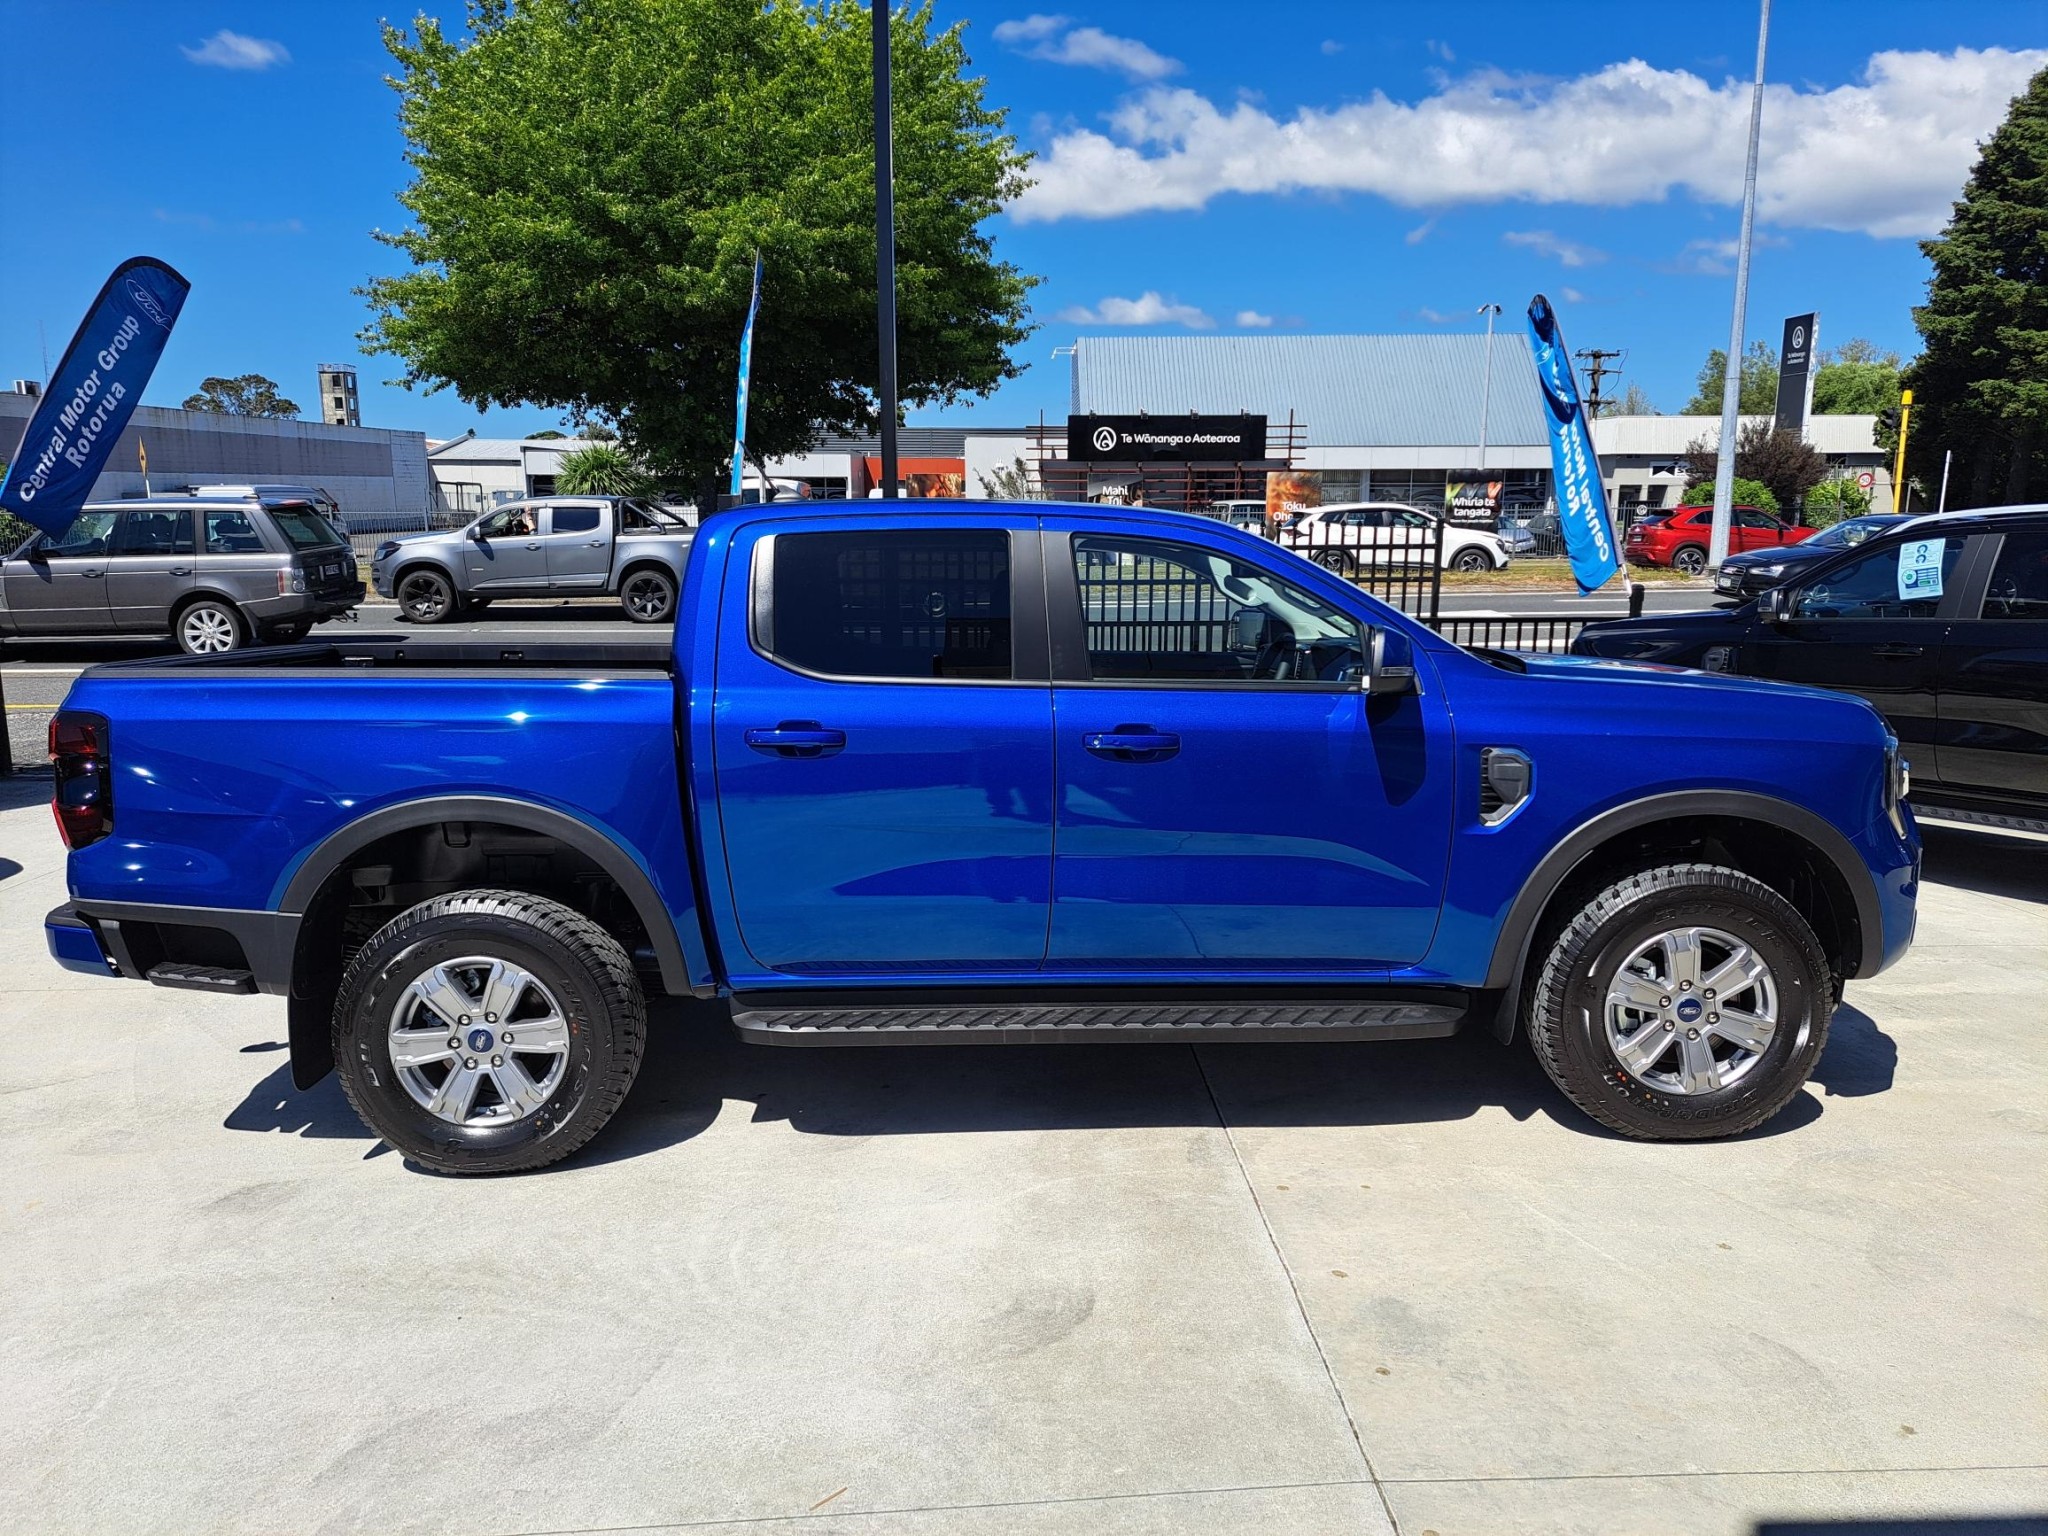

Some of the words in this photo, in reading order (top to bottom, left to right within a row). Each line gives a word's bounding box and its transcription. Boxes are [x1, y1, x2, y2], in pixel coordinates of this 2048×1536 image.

[131, 289, 170, 327] Ford
[20, 427, 67, 502] Central
[60, 369, 101, 431] Motor
[98, 315, 141, 371] Group
[65, 381, 127, 469] Rotorua
[1121, 433, 1132, 443] Te
[1134, 433, 1183, 446] Wānanga
[1193, 433, 1241, 443] Aotearoa
[1102, 485, 1128, 496] Mahi
[1452, 497, 1483, 506] Whiria
[1484, 497, 1495, 506] te
[1454, 507, 1492, 518] tangata
